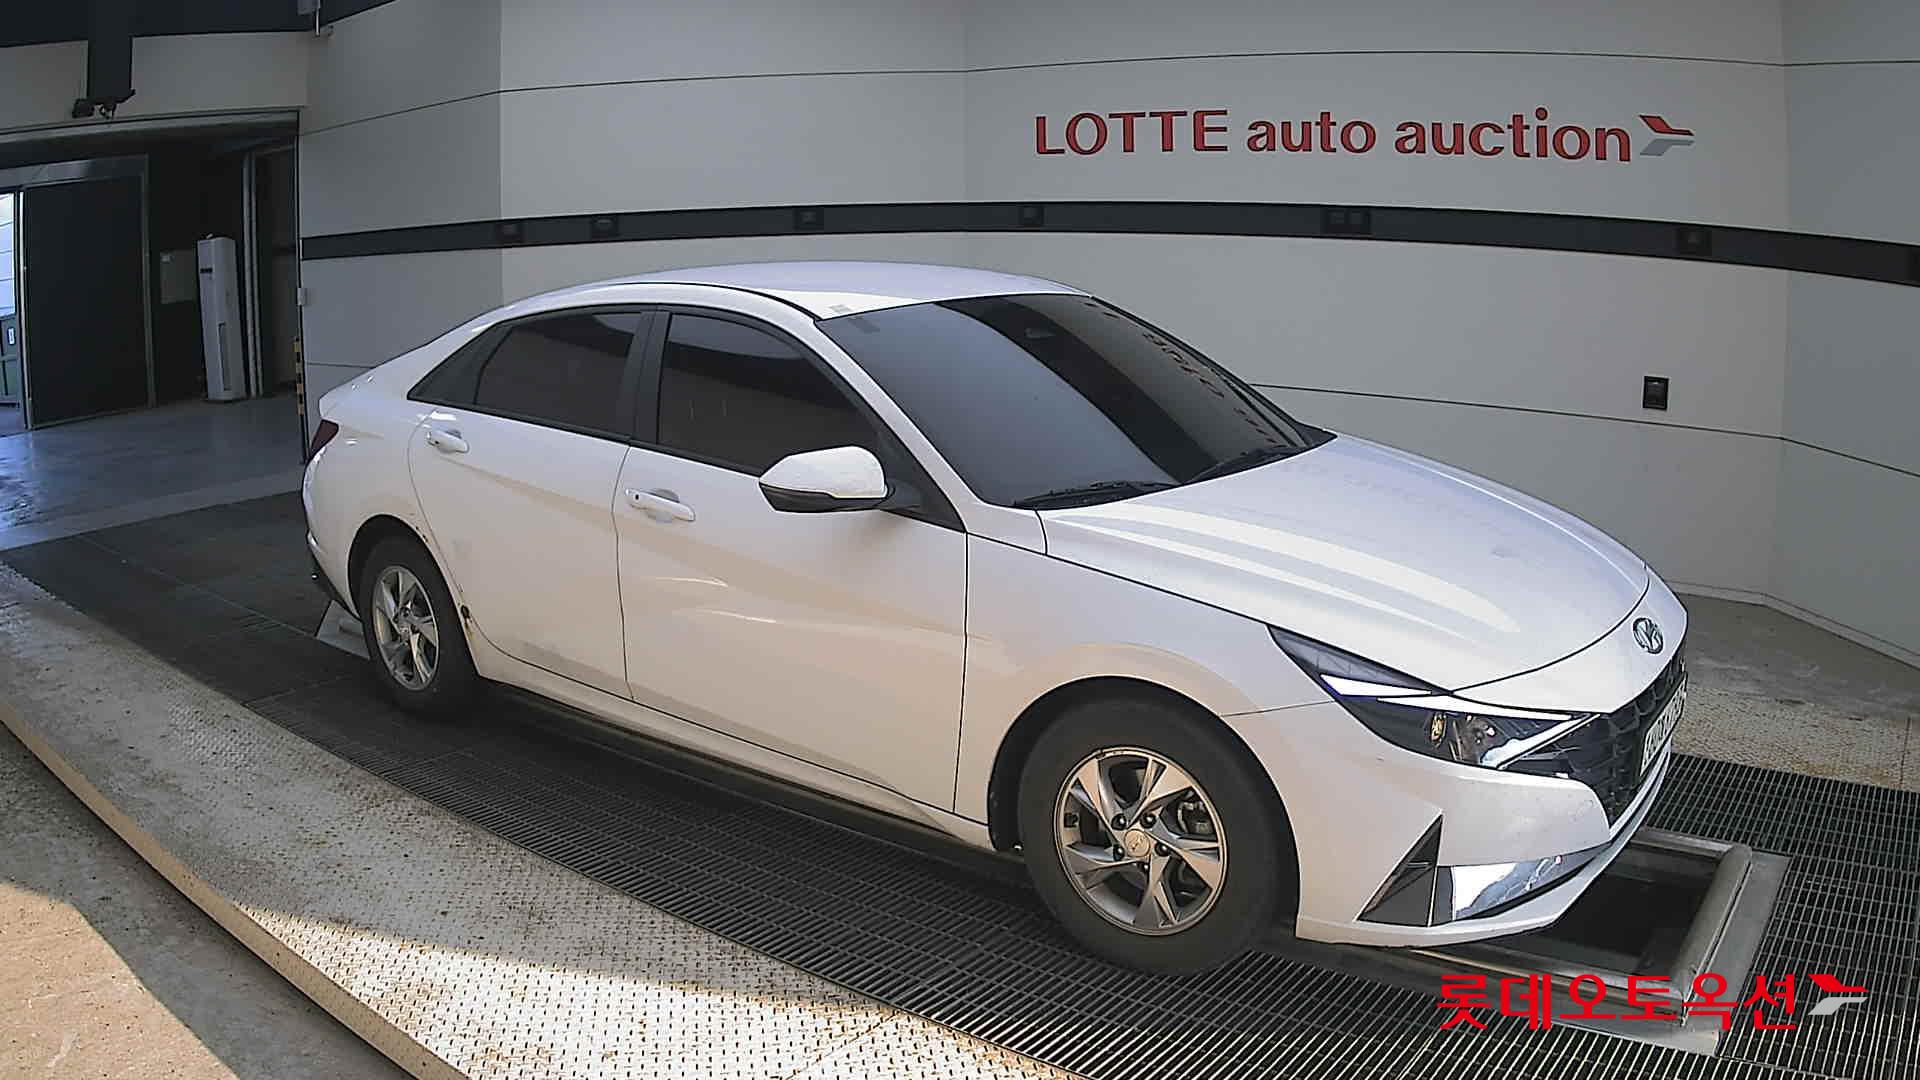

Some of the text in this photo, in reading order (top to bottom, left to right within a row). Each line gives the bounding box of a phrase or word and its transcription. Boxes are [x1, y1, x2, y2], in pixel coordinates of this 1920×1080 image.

[1035, 106, 1632, 162] LOTTE auto auction
